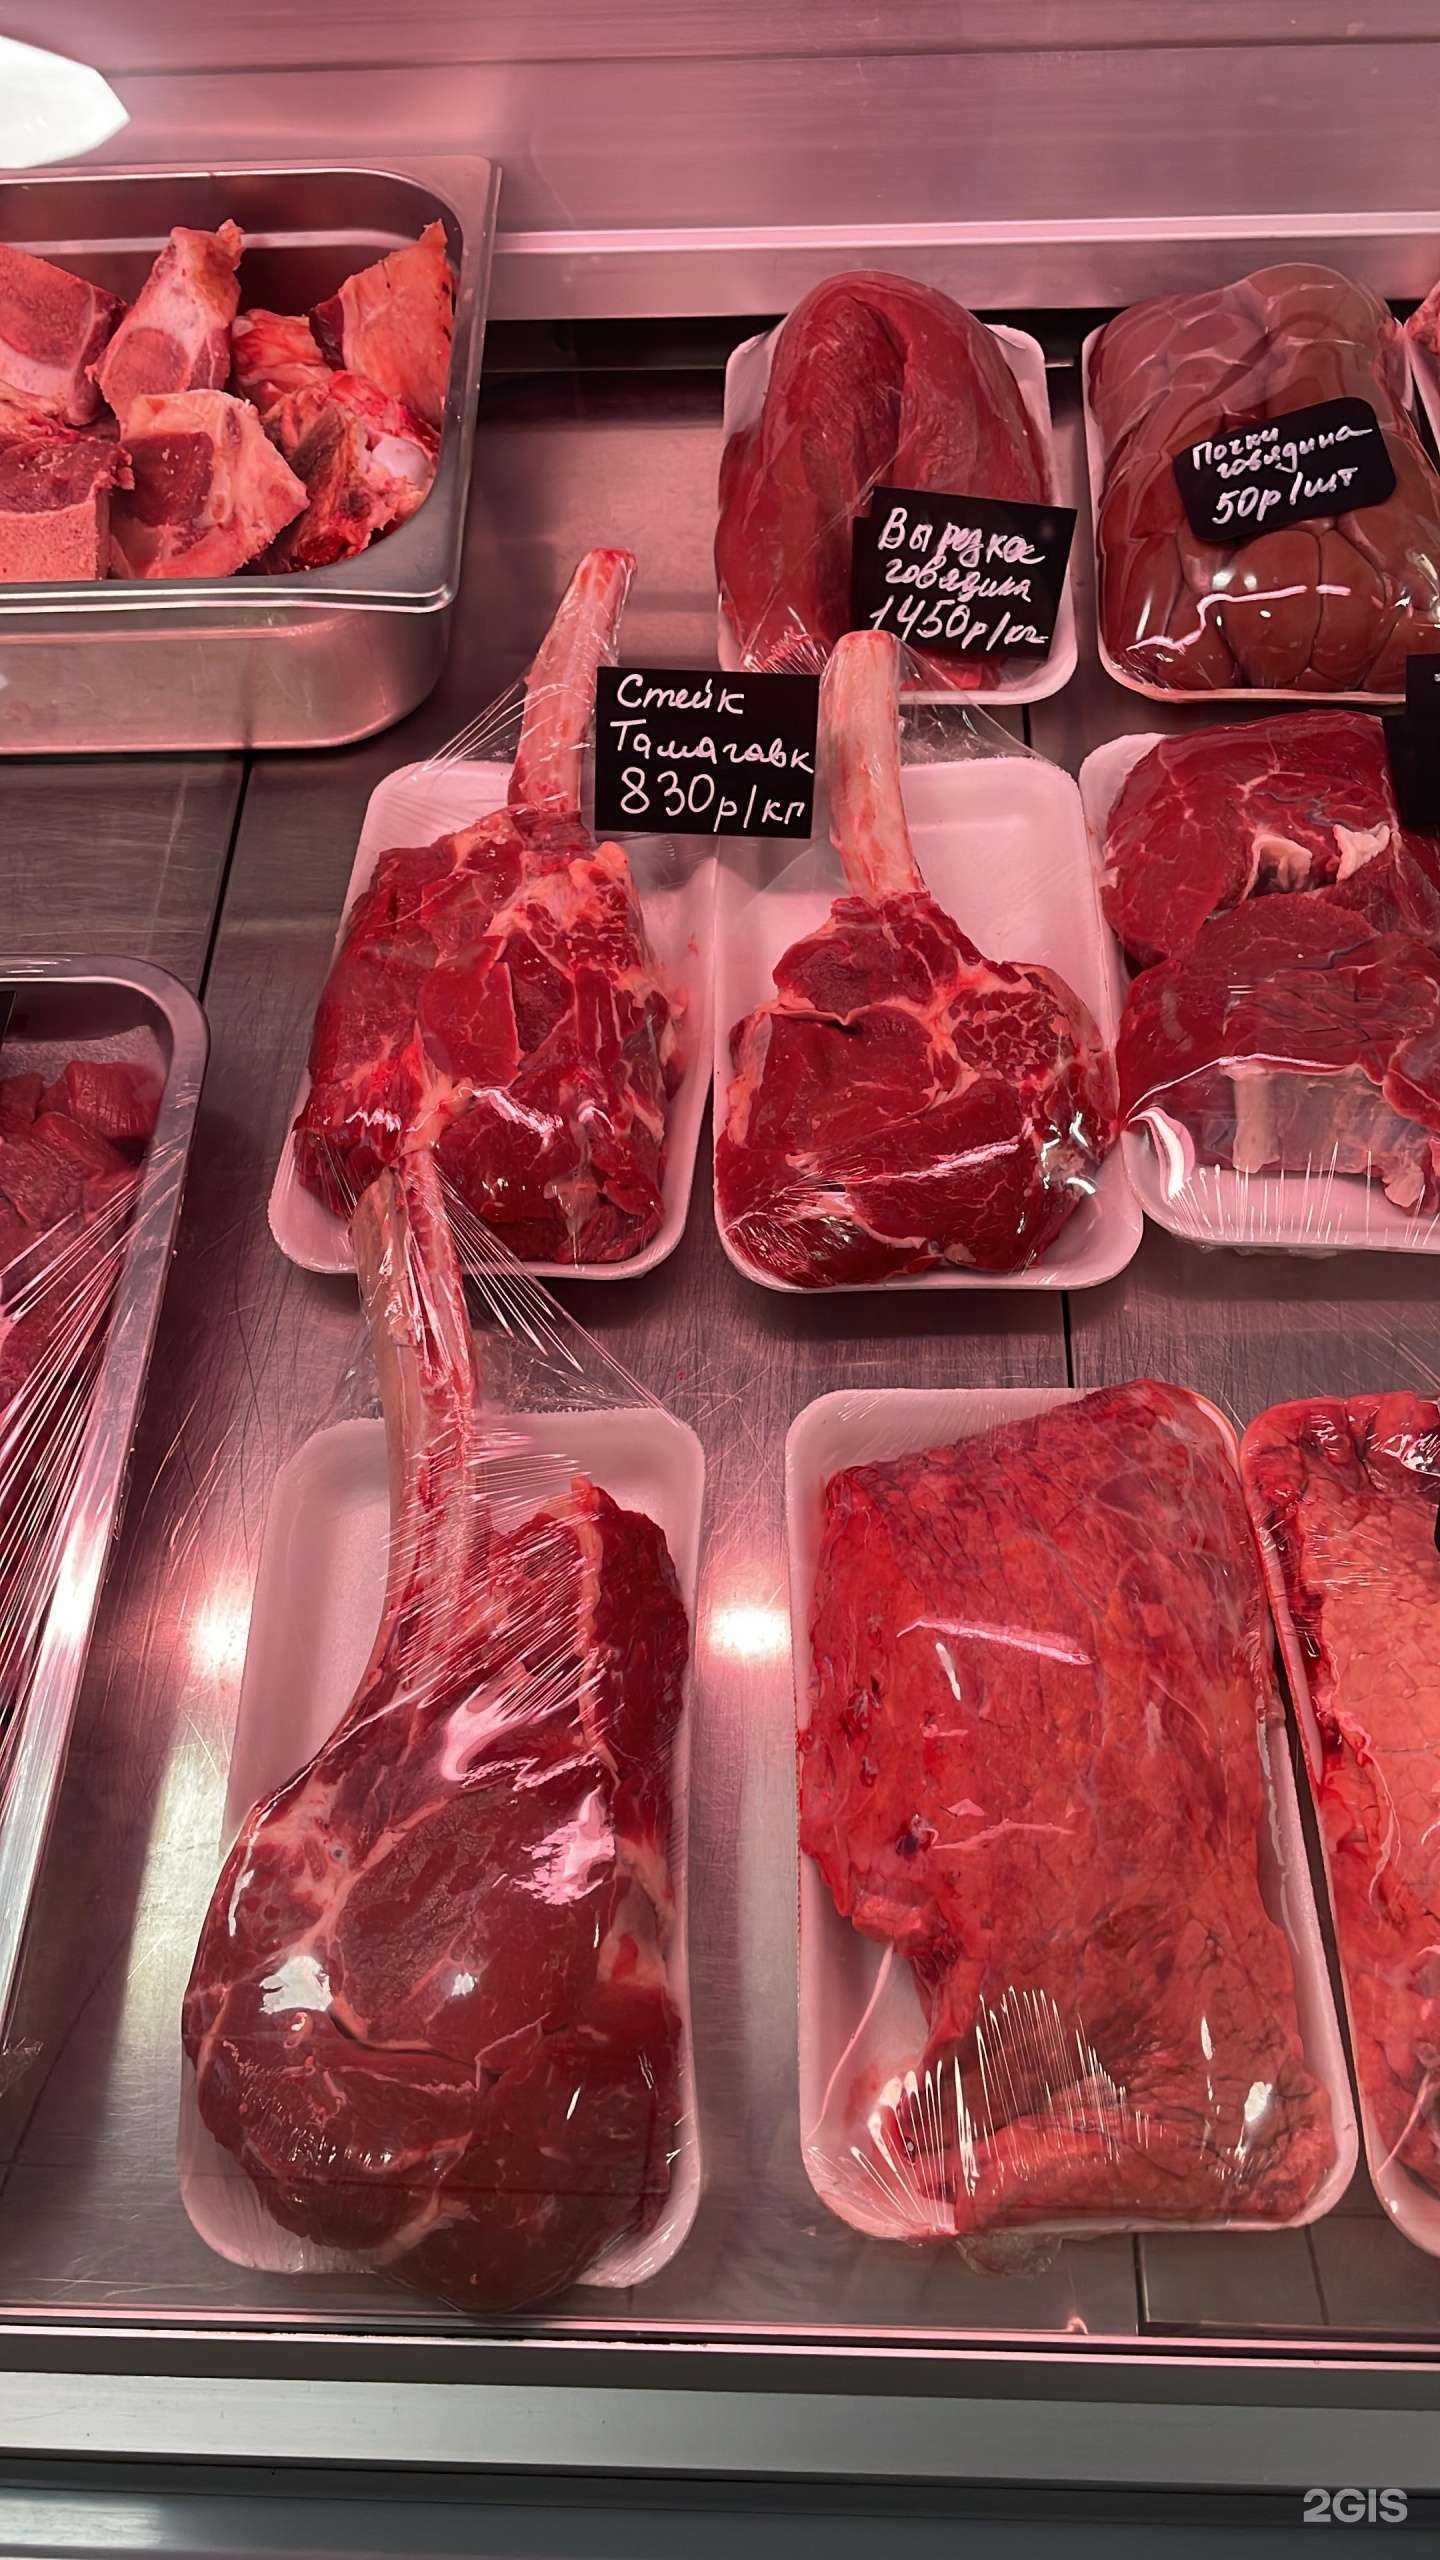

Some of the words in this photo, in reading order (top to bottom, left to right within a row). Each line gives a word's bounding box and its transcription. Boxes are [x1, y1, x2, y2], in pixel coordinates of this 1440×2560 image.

[1192, 427, 1280, 470] Почки
[1216, 425, 1373, 480] говядина
[1212, 467, 1359, 525] 50р/шт
[878, 507, 1046, 568] Вырезка
[884, 554, 1032, 603] говядина
[869, 595, 1049, 652] 1450р/кг
[616, 673, 745, 715] Стейк
[620, 766, 806, 833] 830р/кг
